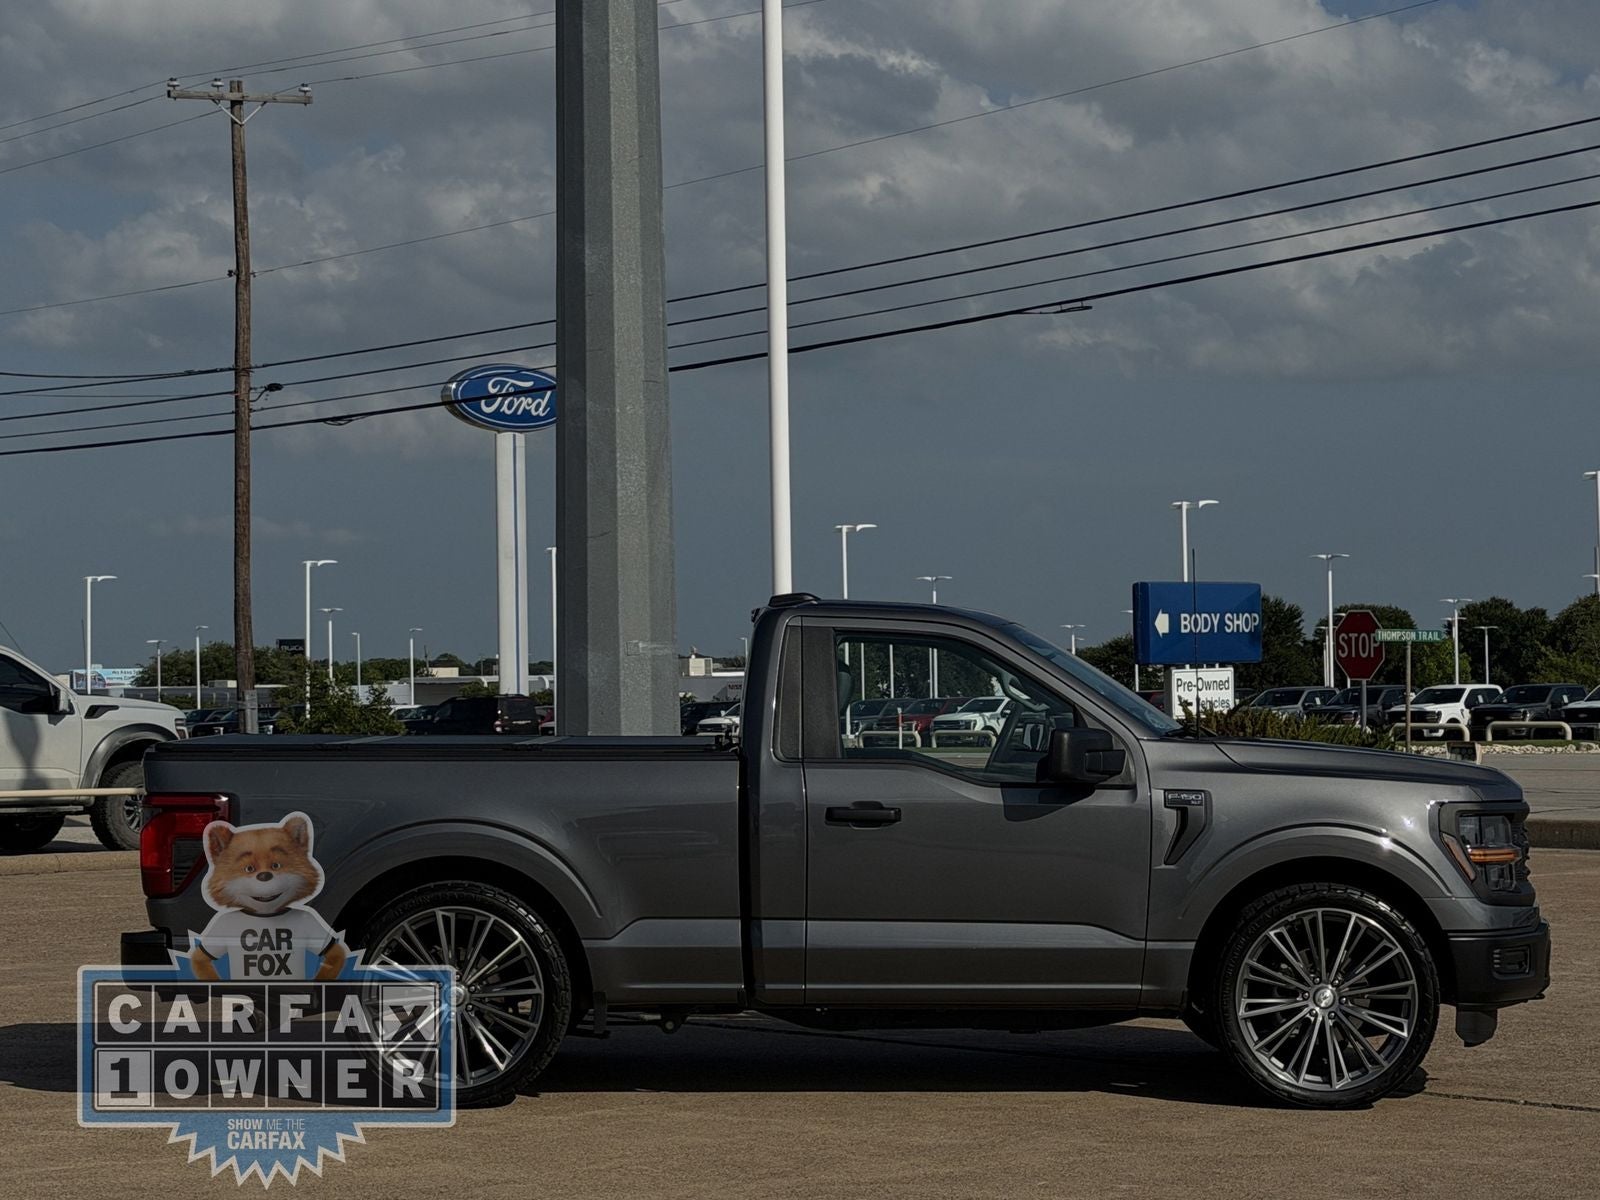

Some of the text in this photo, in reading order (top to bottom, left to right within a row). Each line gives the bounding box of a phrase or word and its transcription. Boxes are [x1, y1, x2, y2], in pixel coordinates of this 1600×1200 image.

[480, 376, 552, 417] Ford
[1180, 612, 1259, 633] BODY SHOP
[1378, 631, 1441, 641] THOMPSON TRAIL
[1338, 633, 1380, 658] STOP
[1176, 676, 1230, 692] Pre-Owned
[1197, 696, 1231, 710] ehicles
[1168, 793, 1202, 801] F-150
